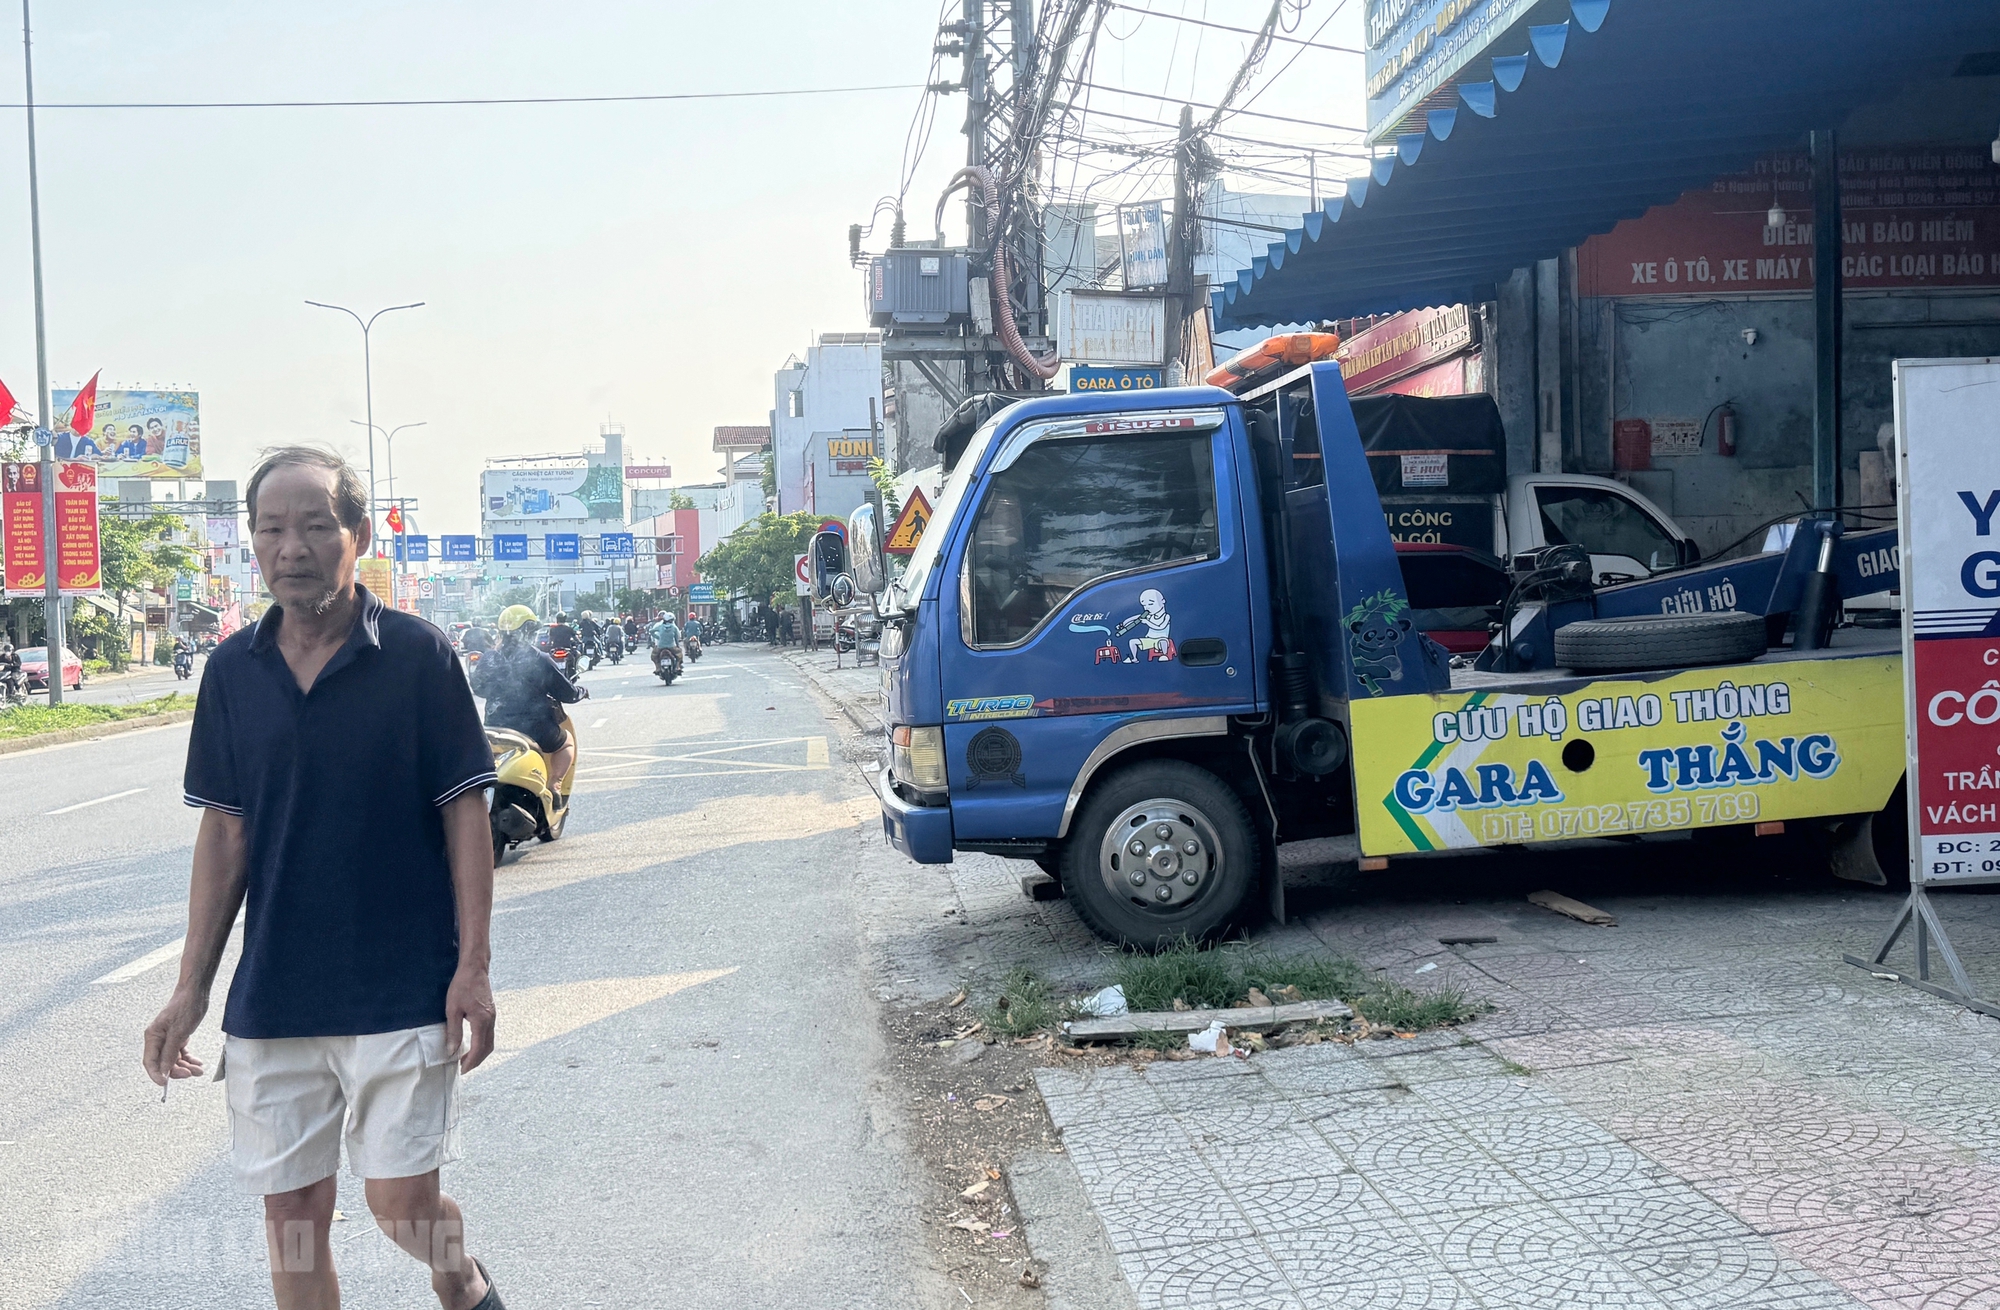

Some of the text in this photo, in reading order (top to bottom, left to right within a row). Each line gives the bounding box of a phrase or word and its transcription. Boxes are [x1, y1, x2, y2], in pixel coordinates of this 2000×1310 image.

[1841, 193, 1874, 207] otline:
[1763, 212, 1975, 246] ĐIỂM ÁN BẢO HIỂM
[1631, 262, 1657, 284] XE
[1664, 257, 1678, 282] Ô
[1684, 256, 1716, 284] TÔ,
[1722, 259, 1749, 281] XE
[1756, 254, 1800, 280] MÁY
[1841, 252, 1883, 277] CÁC
[1890, 254, 1936, 280] LOẠI
[1944, 246, 1984, 276] BẢO
[1077, 374, 1154, 390] GARA Ô TÔ
[1109, 419, 1180, 431] ISUZU
[1398, 509, 1452, 526] CÔNG
[1661, 578, 1737, 615] CỨU HỘ
[951, 696, 1033, 714] TURBO
[1432, 680, 1791, 744] CỨU HỘ GIAO THÔNG
[1394, 721, 1842, 815] GARA THẮNG
[1482, 791, 1761, 842] ĐT: 0702.735 769
[1927, 801, 1996, 824] VÁCH
[1937, 841, 1980, 854] ĐC:
[1932, 862, 1972, 874] ĐT:
